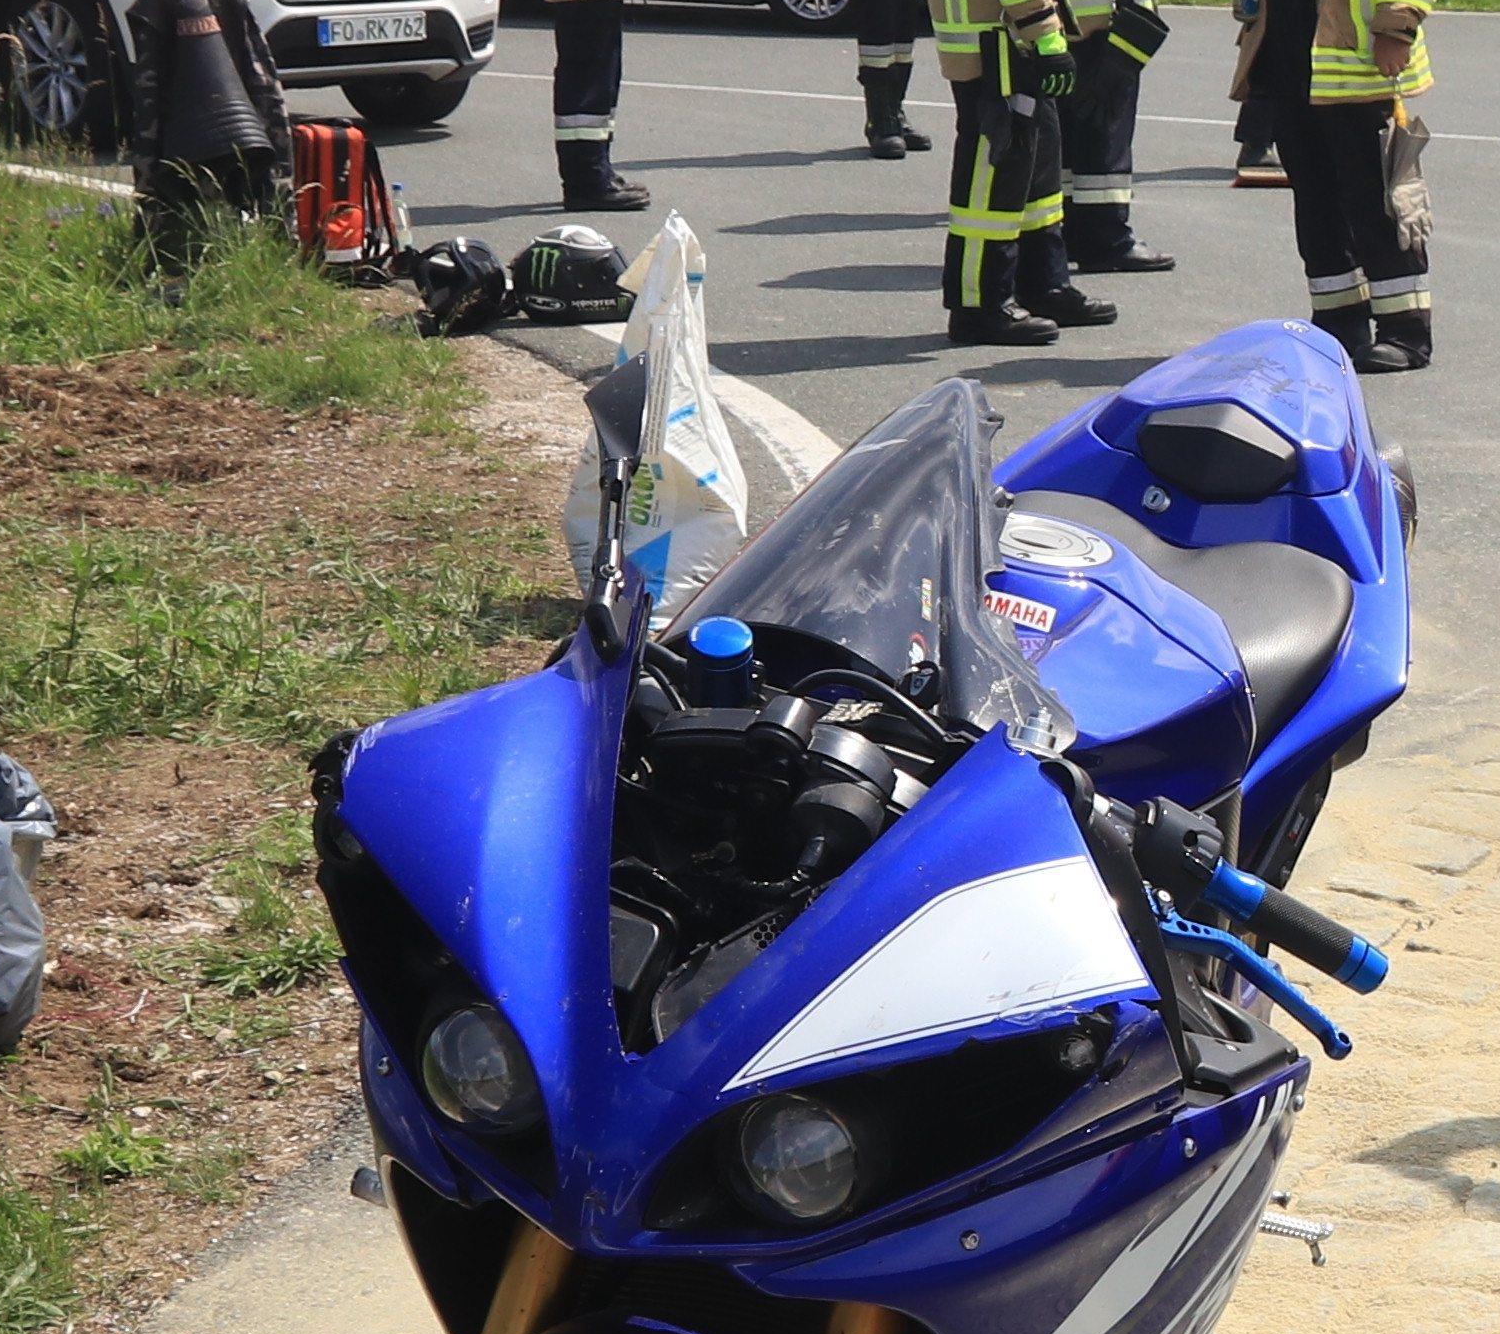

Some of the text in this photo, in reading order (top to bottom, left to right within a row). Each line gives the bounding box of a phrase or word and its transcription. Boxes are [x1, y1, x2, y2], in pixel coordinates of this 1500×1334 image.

[331, 17, 424, 42] FO RK 762
[983, 593, 1048, 628] AMAHA
